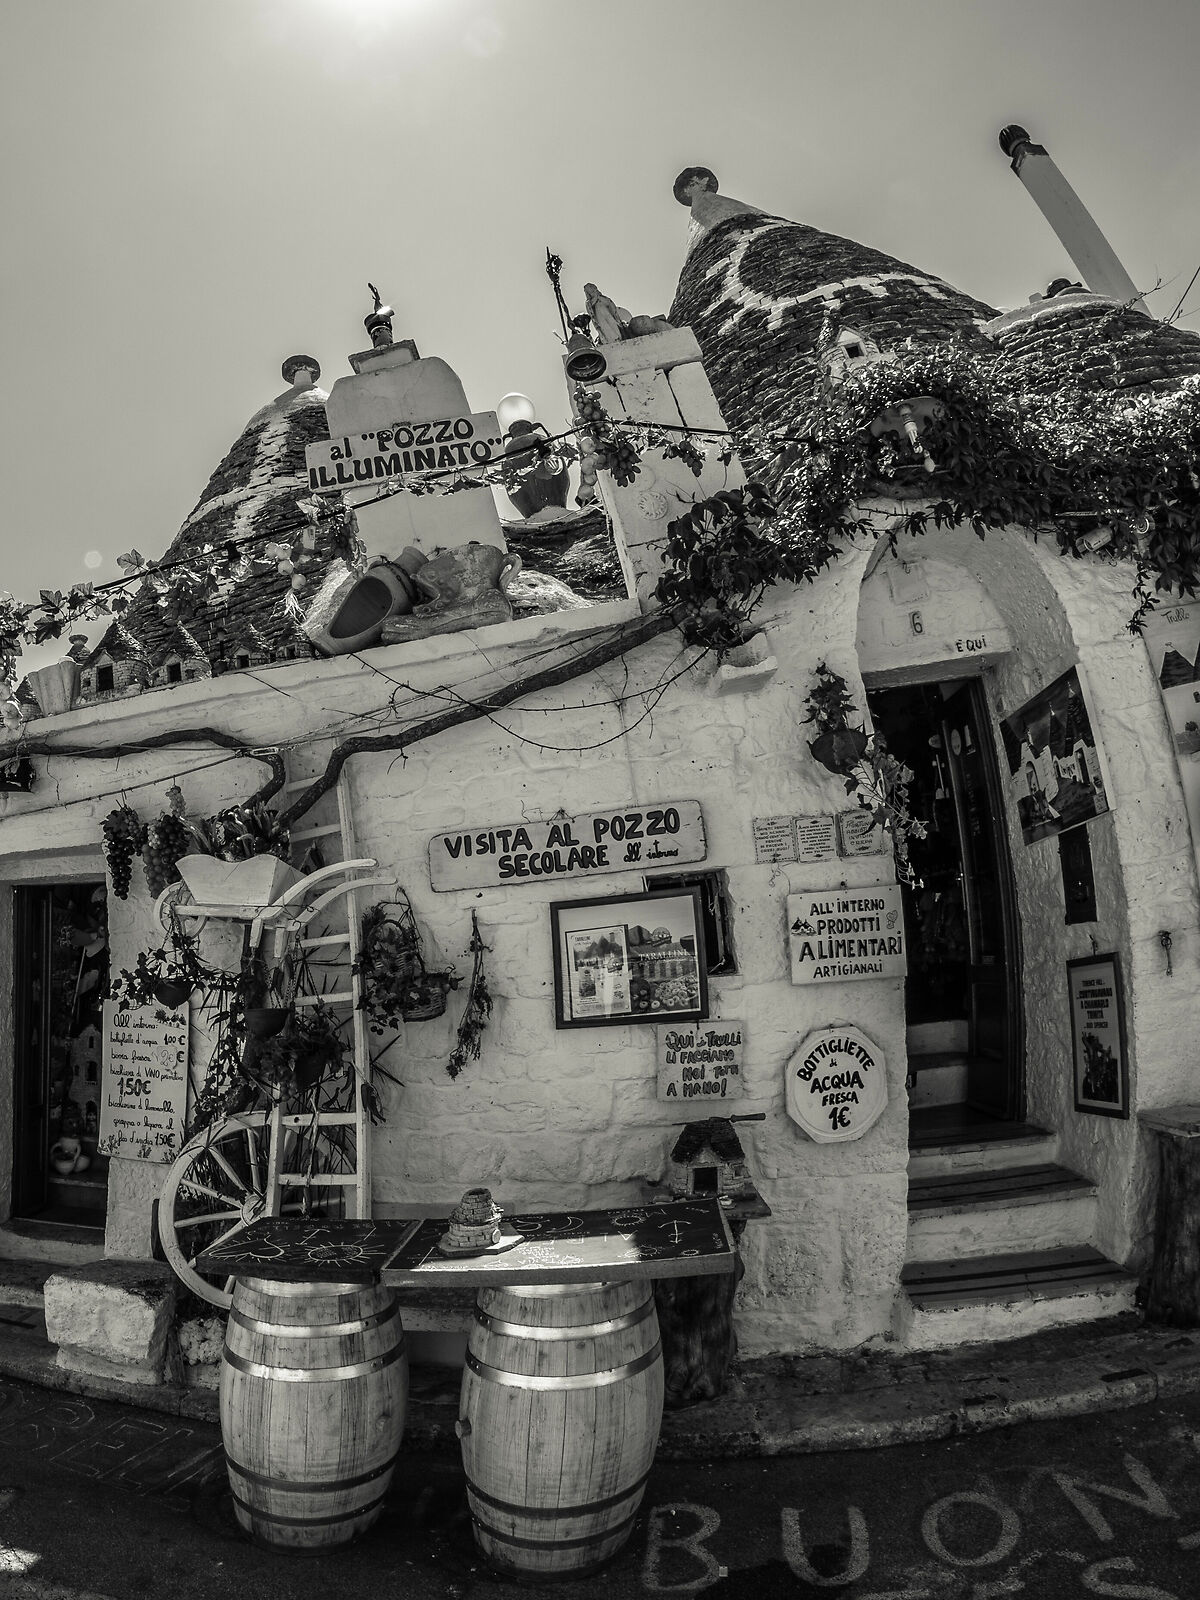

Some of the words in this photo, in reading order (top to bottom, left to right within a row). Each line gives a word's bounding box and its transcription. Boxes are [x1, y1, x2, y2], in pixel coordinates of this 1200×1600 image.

[330, 438, 352, 460] al
[911, 612, 924, 634] 6
[444, 828, 533, 858] VISITA
[546, 823, 579, 848] AL
[593, 808, 680, 843] POZZO
[499, 845, 610, 879] SECOLARE
[817, 913, 881, 935] PRODOTTI
[799, 931, 903, 962] ALIMENTARI
[813, 959, 883, 979] ARTIGIANALI
[665, 1031, 695, 1052] QUI
[705, 1031, 742, 1047] TRULLI
[666, 1050, 676, 1064] LI
[680, 1048, 735, 1064] FACCIAMO
[797, 1037, 875, 1082] BOTTIGLIETTE
[682, 1064, 705, 1081] NOI
[810, 1071, 864, 1094] ACQUA
[666, 1082, 678, 1097] A
[683, 1078, 728, 1097] MANO!
[821, 1091, 859, 1106] FRESCA
[828, 1107, 851, 1130] 1€
